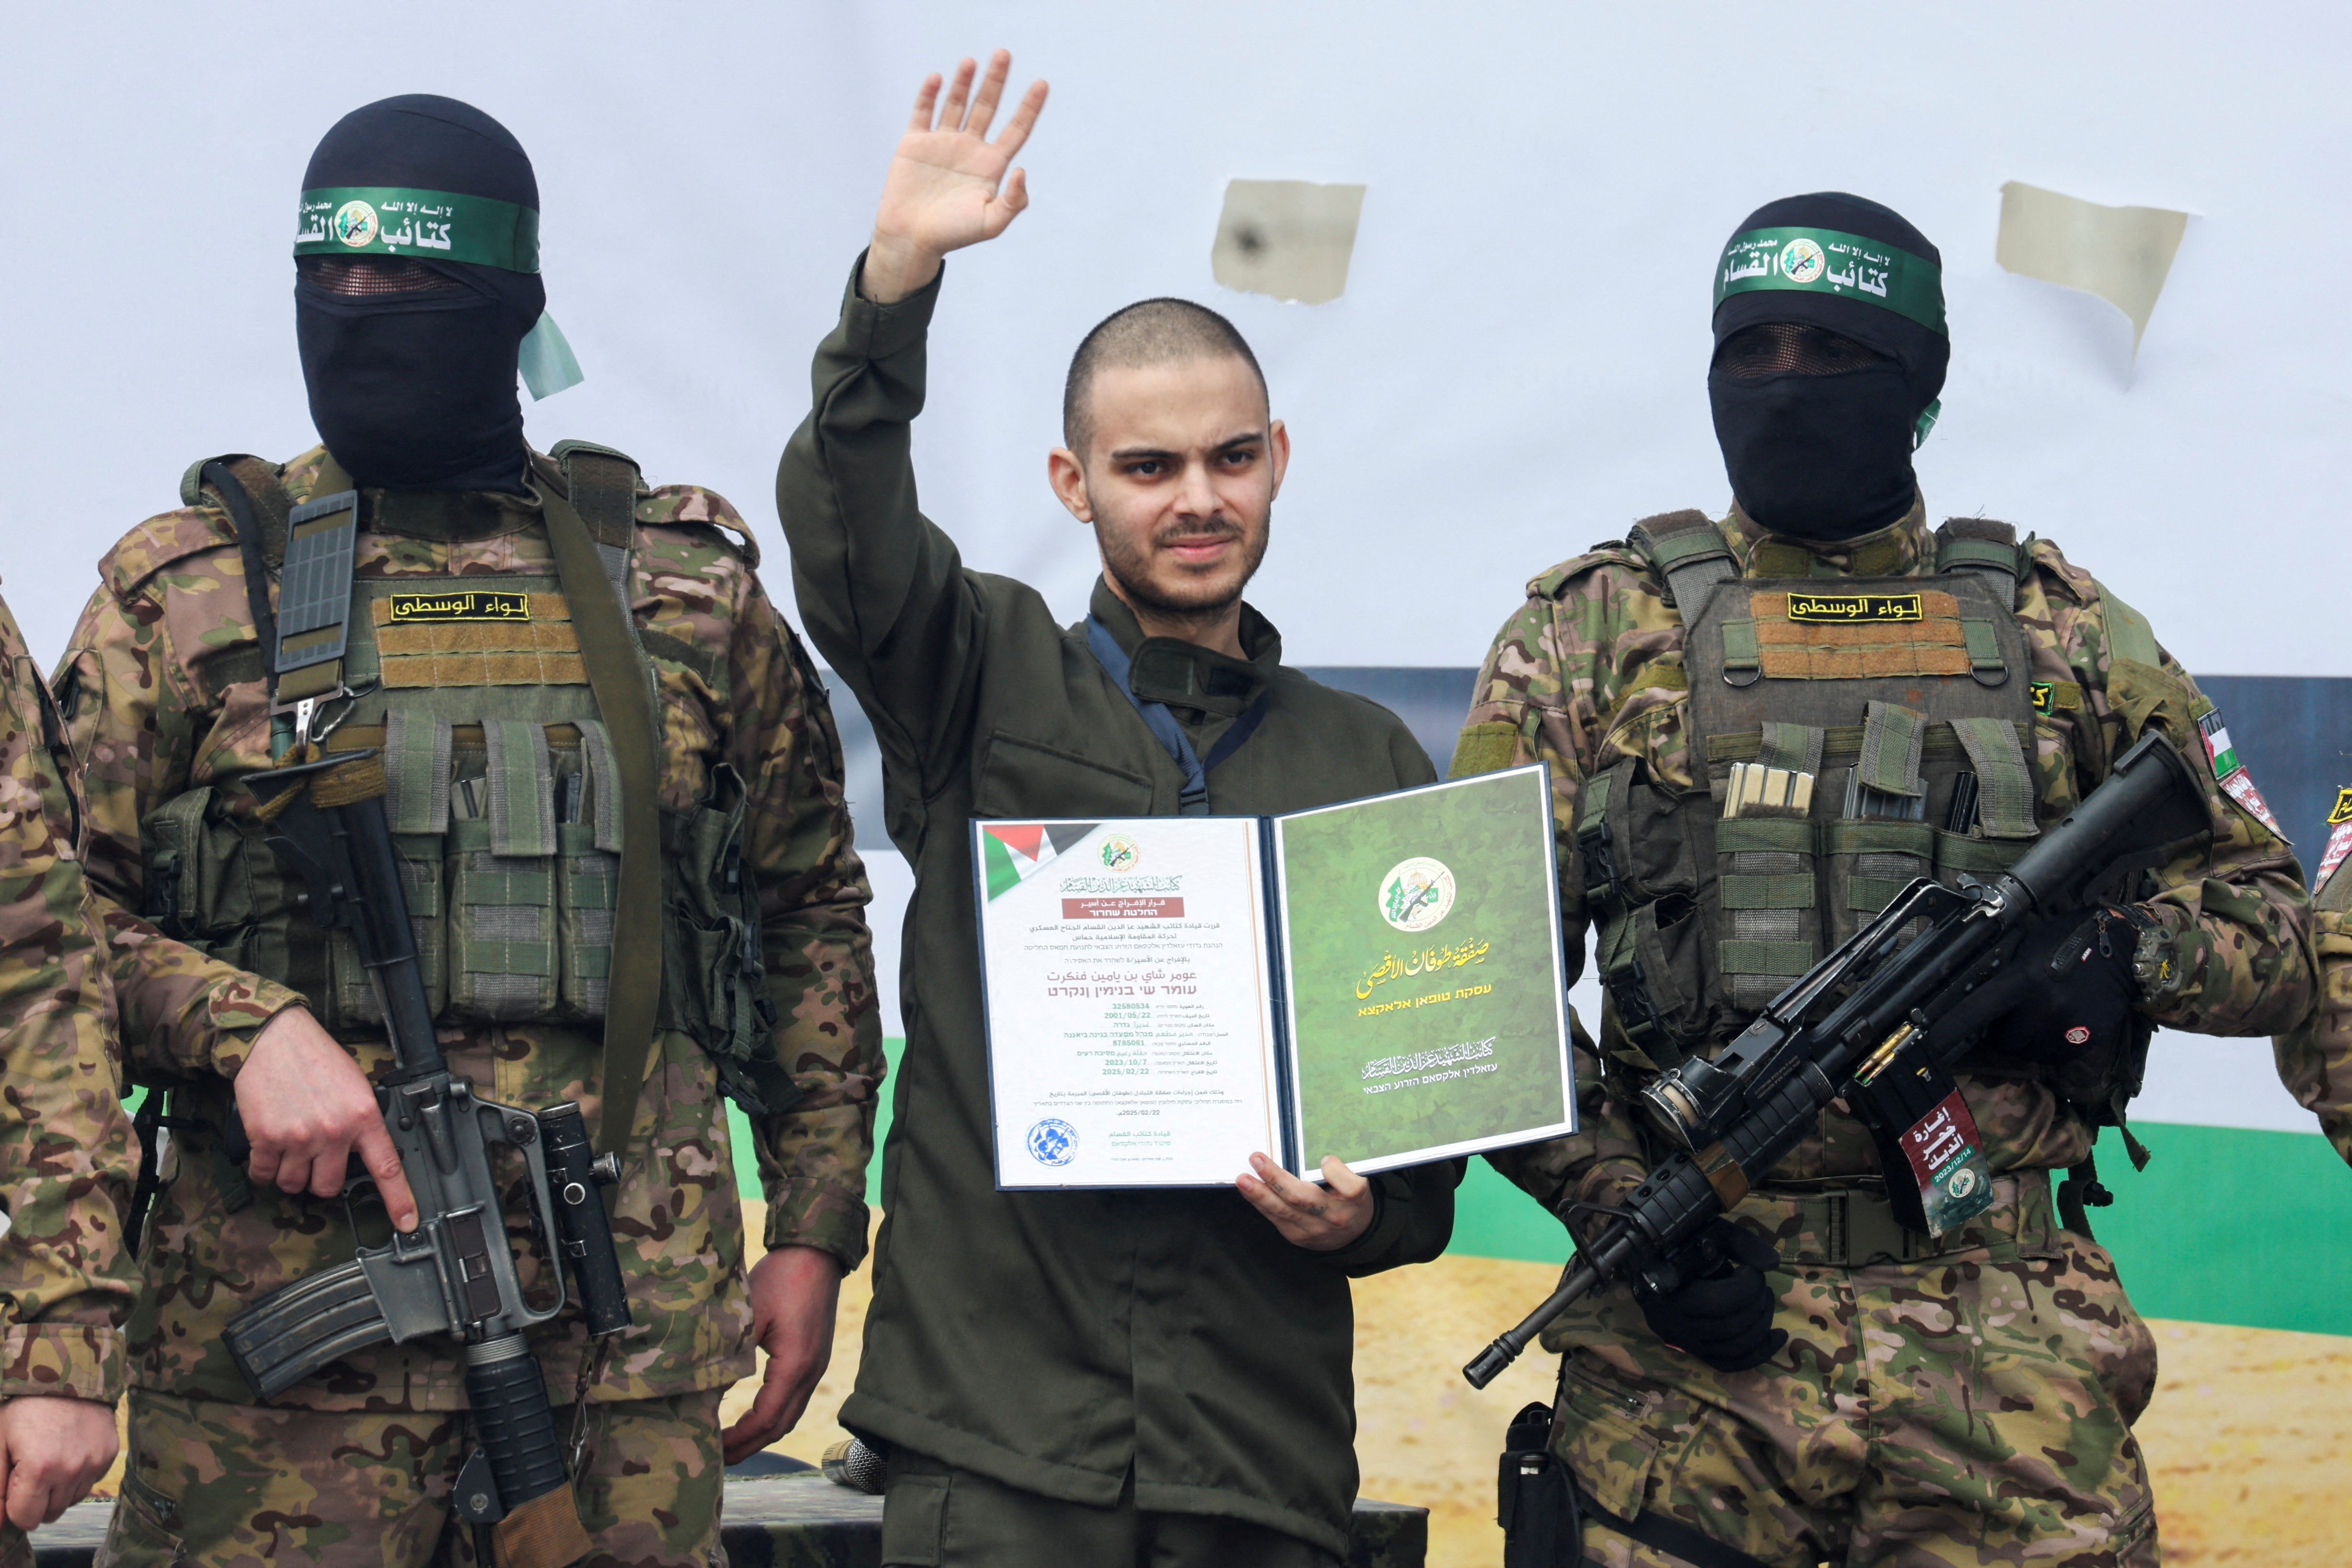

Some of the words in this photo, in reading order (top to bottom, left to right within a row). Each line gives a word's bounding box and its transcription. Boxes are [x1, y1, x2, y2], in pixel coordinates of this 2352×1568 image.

[315, 202, 332, 211] محمد
[381, 201, 403, 211] الله
[446, 206, 453, 217] لا
[380, 217, 451, 253] كتائب
[1757, 238, 1777, 248] محمد
[1829, 242, 1850, 253] الله
[1884, 256, 1890, 267] لا
[1723, 250, 1778, 291] القسام
[1827, 261, 1889, 298] كتائب
[395, 594, 475, 615] الوسطى
[485, 596, 524, 616] لواء
[1793, 598, 1868, 617] الوسطى
[1878, 599, 1917, 617] لواء
[1029, 925, 1058, 933] العسكري
[1060, 924, 1080, 932] الجناح
[1047, 972, 1087, 983] فنكرت
[1091, 971, 1120, 983] يامين
[1124, 971, 1137, 982] بن
[1142, 968, 1165, 983] شاي
[1170, 971, 1197, 982] عومر
[1095, 986, 1135, 998] בנימין
[1139, 985, 1155, 995] שי
[1161, 985, 1196, 995] עומר
[1455, 984, 1492, 999] עסקת
[1415, 992, 1451, 1008] טופאן
[1358, 999, 1411, 1017] אלאקצא
[1156, 1030, 1176, 1038] مطعم
[1422, 1069, 1460, 1083] אלקסאם
[1462, 1063, 1498, 1078] עזאלדין
[1363, 1082, 1391, 1094] הצבאי
[1394, 1077, 1419, 1090] הזרוע
[1928, 1133, 1964, 1170] الديك
[1935, 1148, 1971, 1183] 2023/12/14
